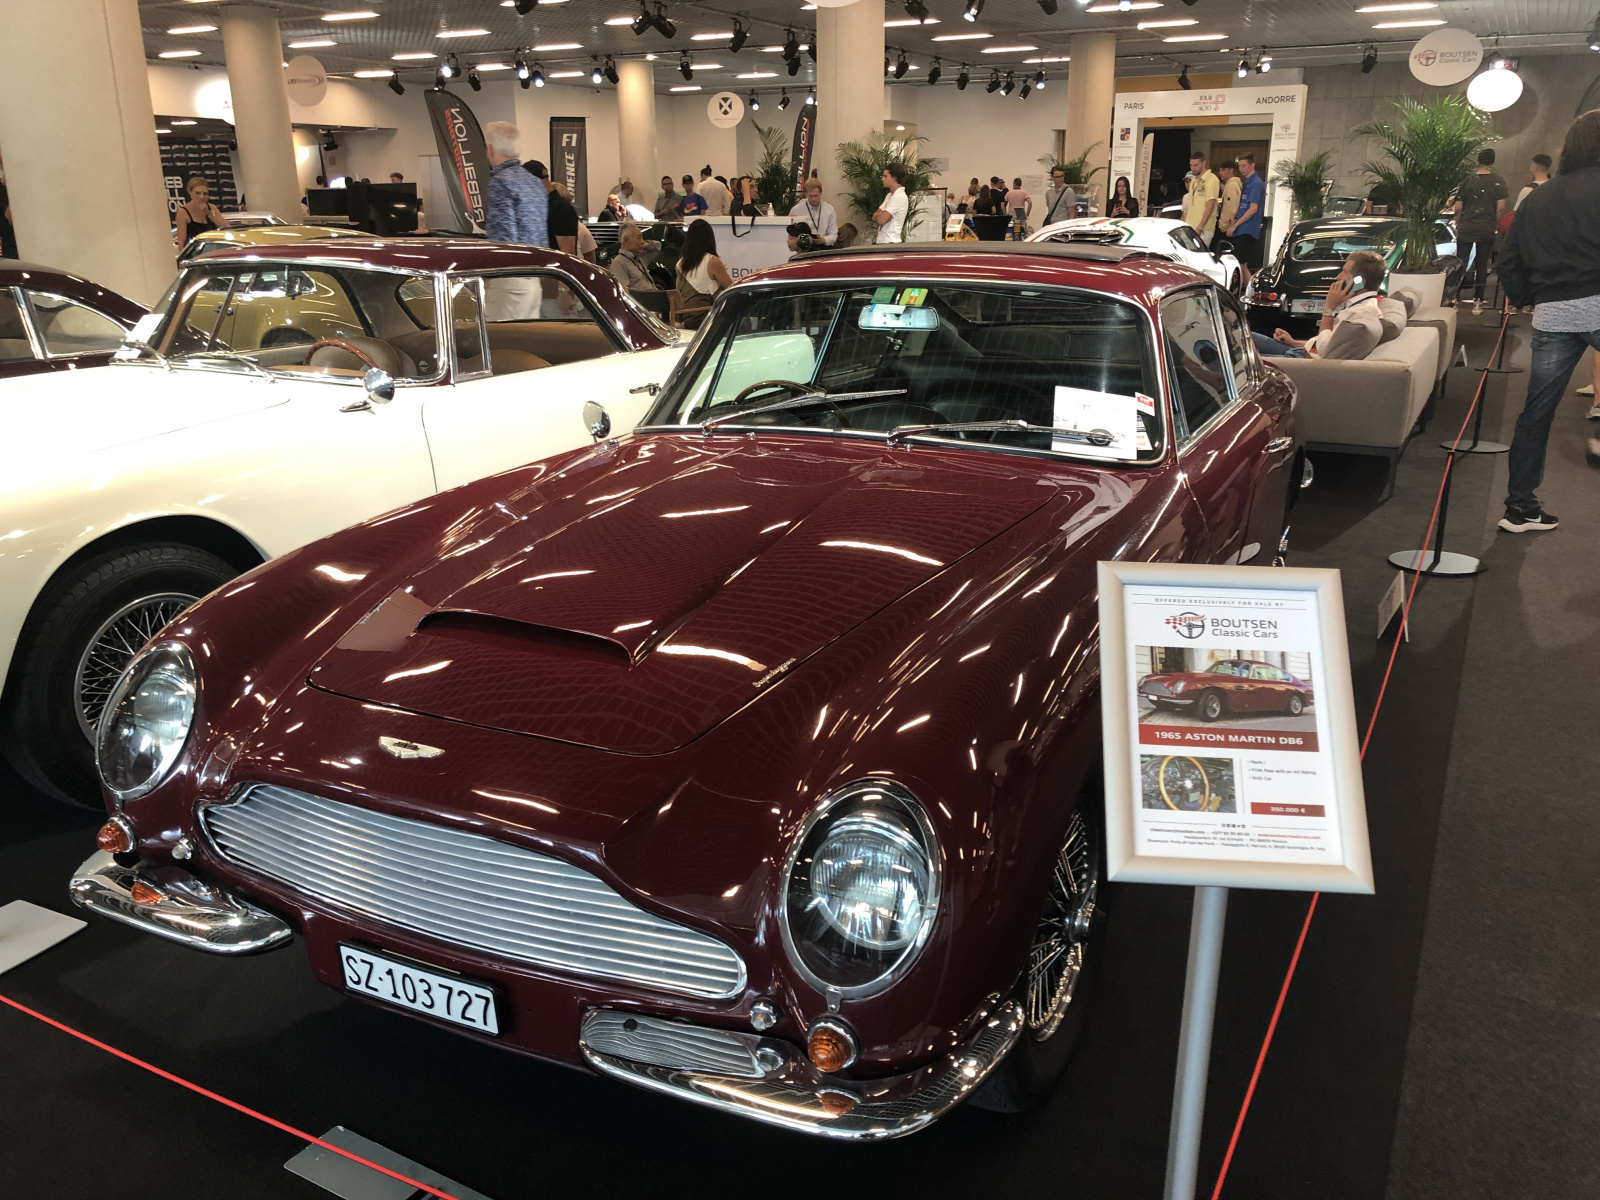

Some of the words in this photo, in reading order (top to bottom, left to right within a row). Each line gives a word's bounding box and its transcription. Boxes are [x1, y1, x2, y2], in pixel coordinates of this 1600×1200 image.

[1256, 95, 1296, 104] ANDORRE
[164, 176, 183, 188] EB
[168, 200, 187, 212] ON
[907, 296, 918, 304] 21
[1211, 618, 1278, 629] BOUTSEN
[1212, 628, 1250, 638] Classic
[1254, 630, 1278, 638] Cars
[1155, 732, 1182, 740] 1965
[1185, 732, 1225, 742] ASTON
[1228, 735, 1276, 744] MARTIN
[1279, 737, 1304, 745] DB6
